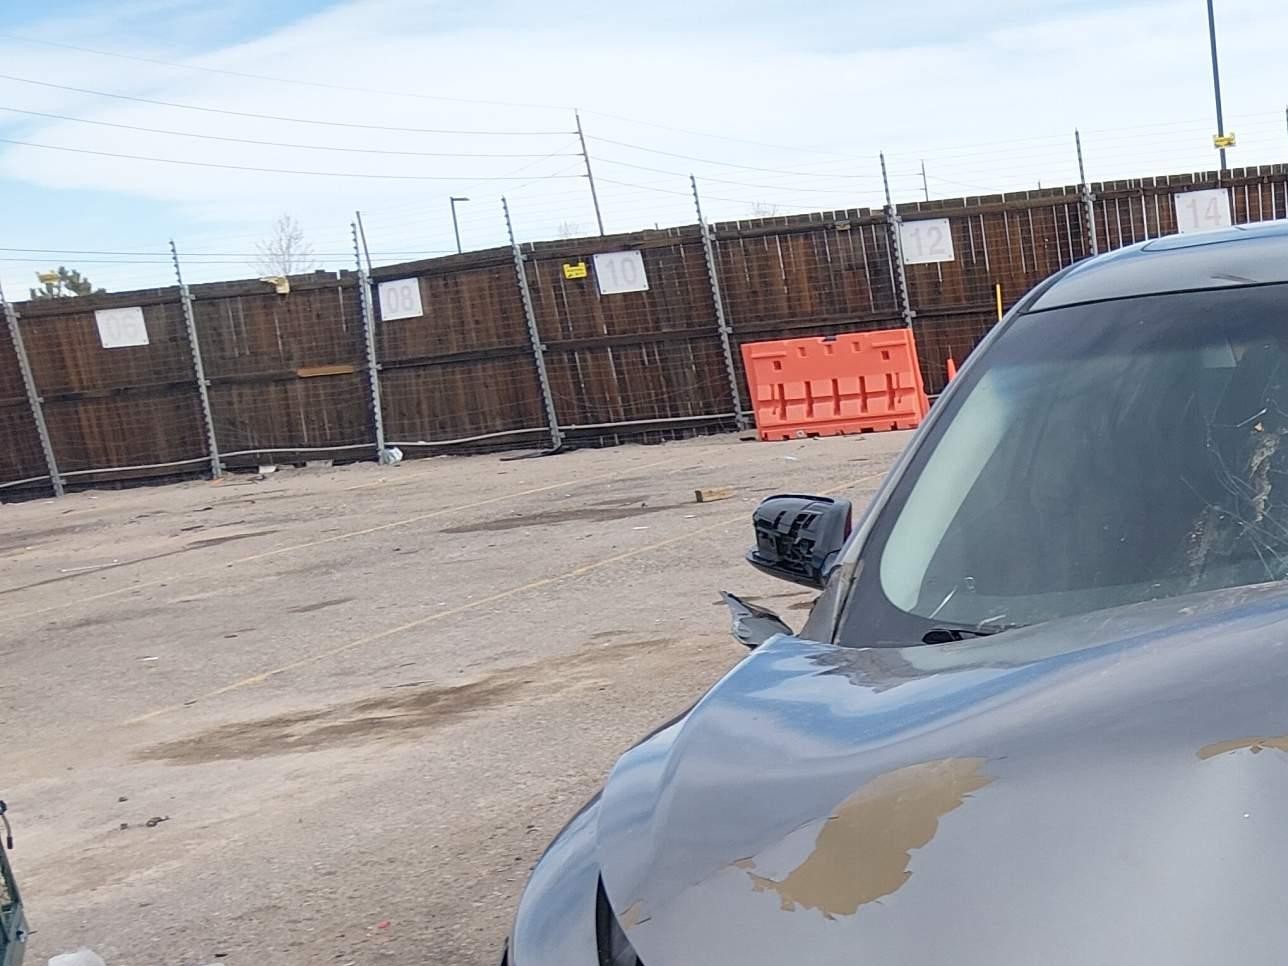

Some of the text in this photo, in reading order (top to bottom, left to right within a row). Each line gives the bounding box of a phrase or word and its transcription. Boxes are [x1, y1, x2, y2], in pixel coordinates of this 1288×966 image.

[1185, 197, 1222, 229] 14
[909, 226, 945, 256] 12
[605, 256, 638, 287] 10
[385, 285, 414, 313] 08
[105, 312, 138, 340] 06
